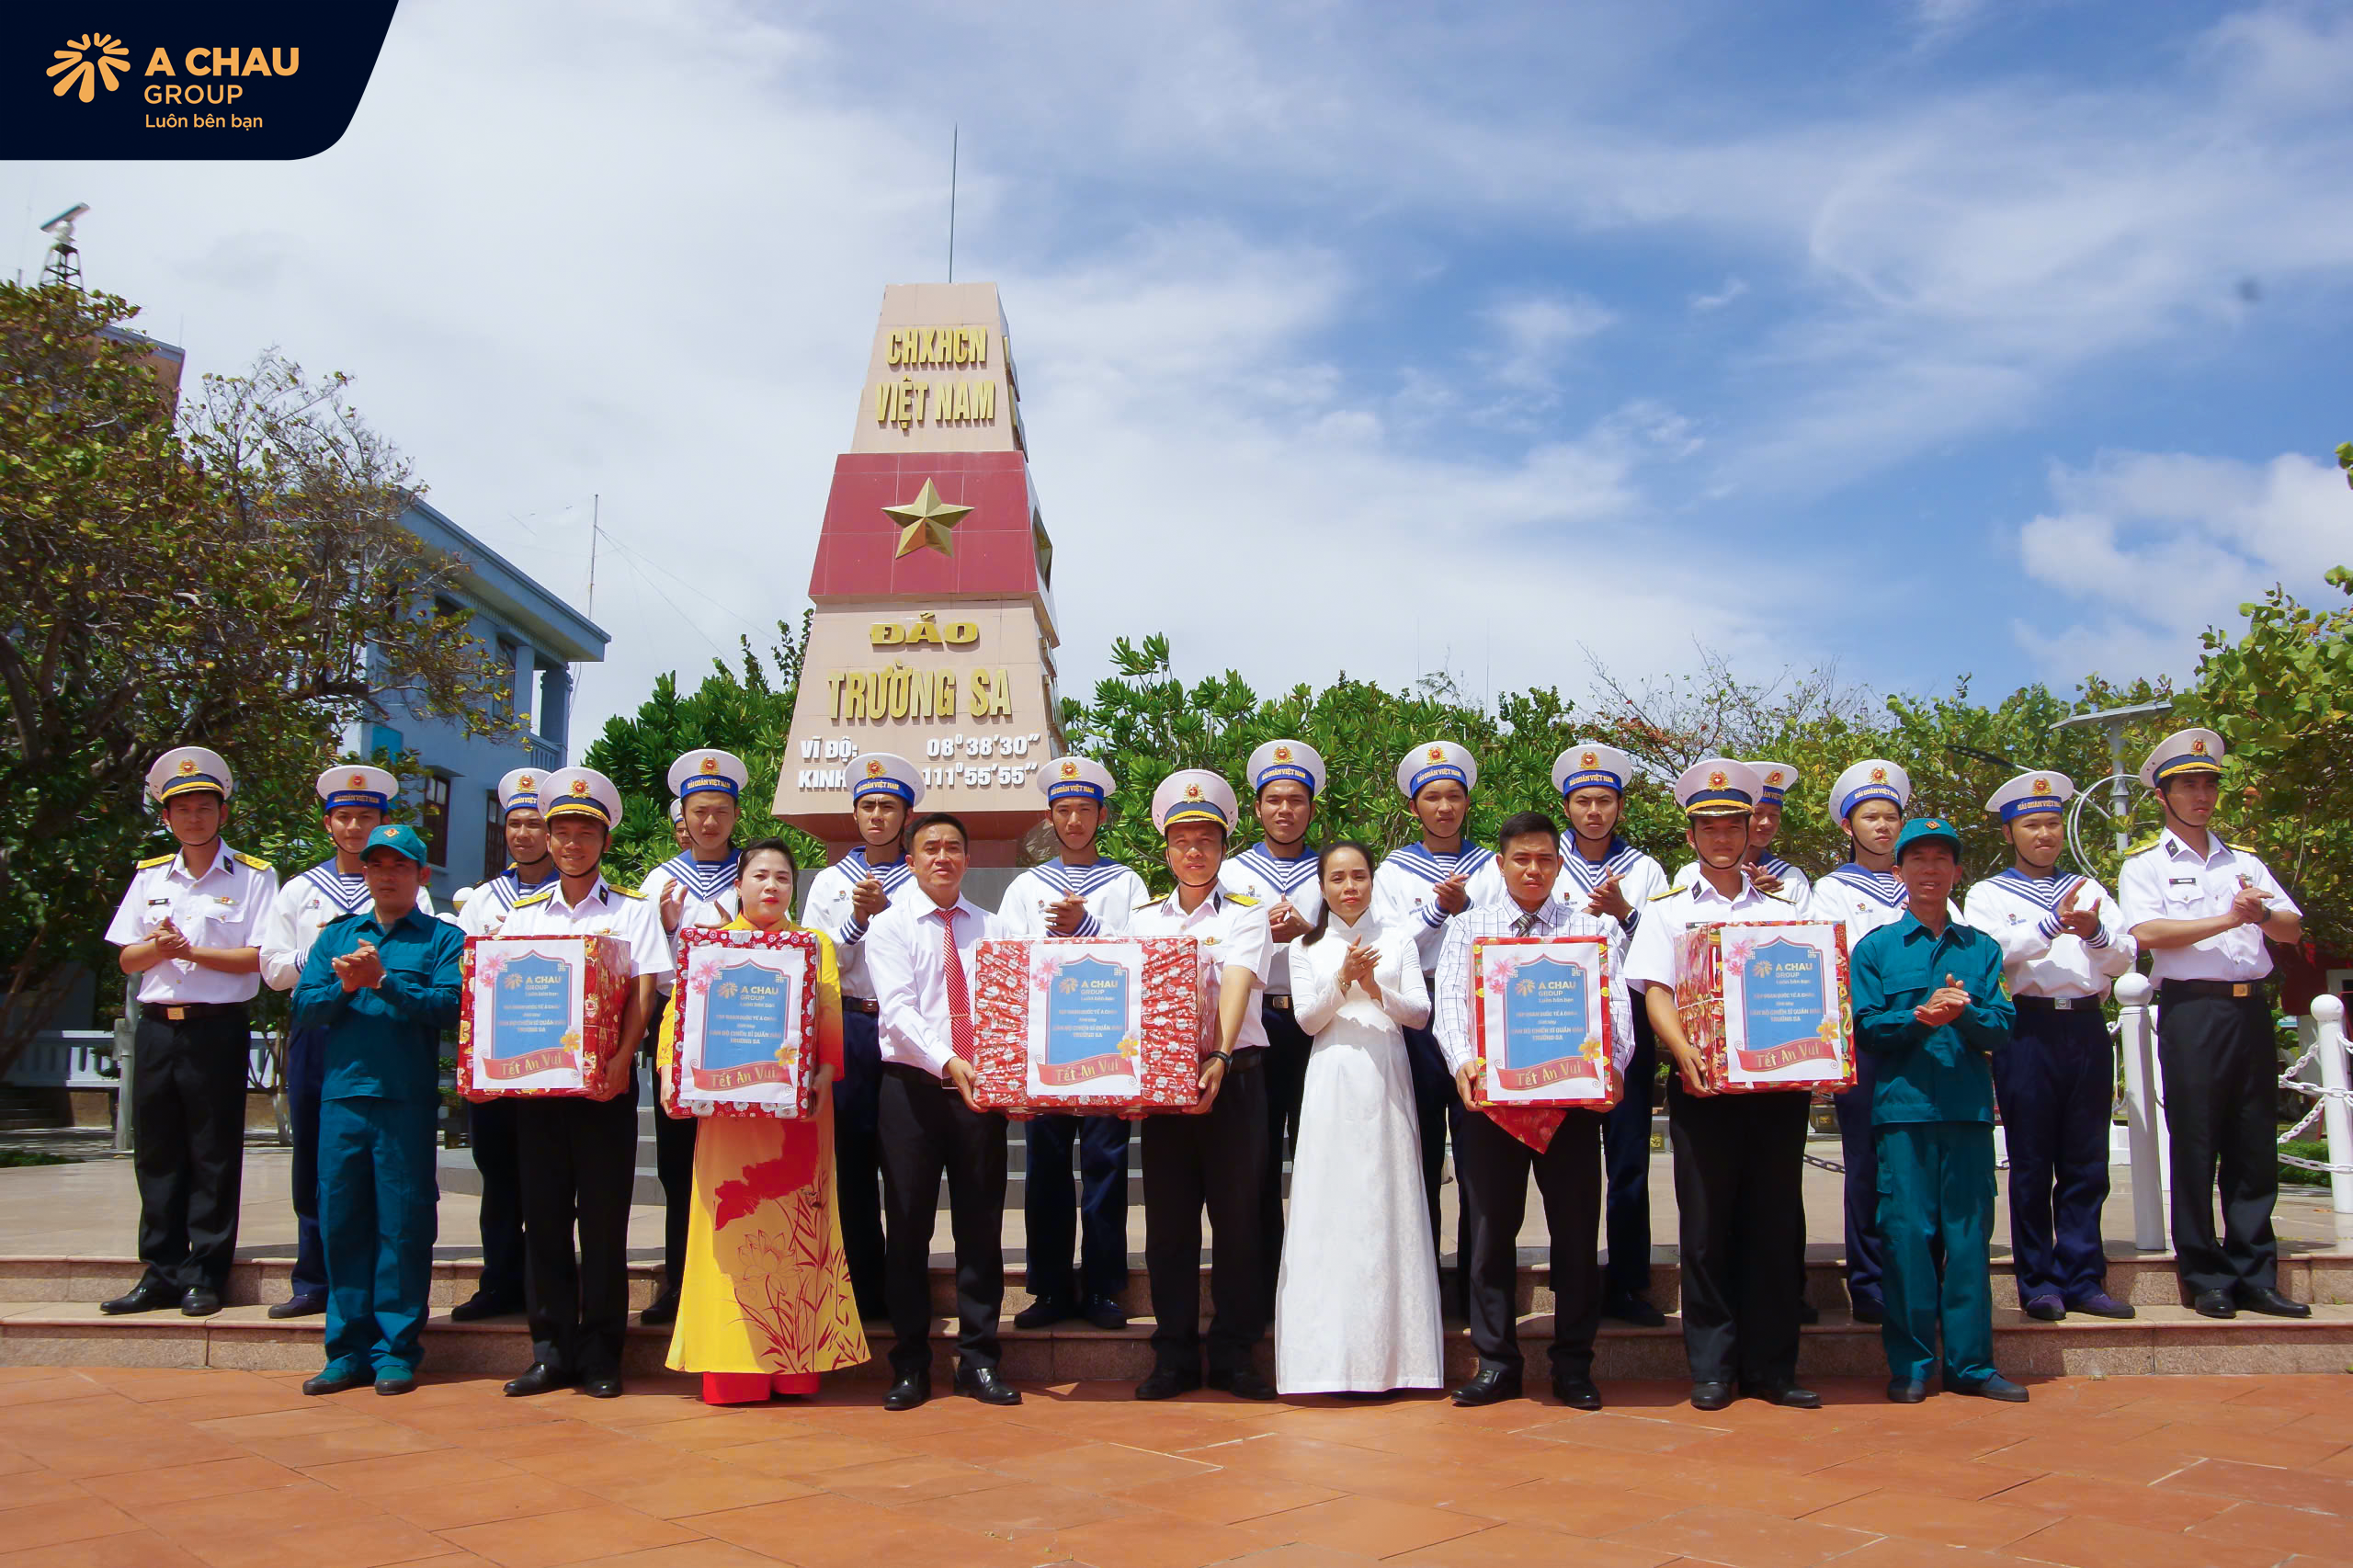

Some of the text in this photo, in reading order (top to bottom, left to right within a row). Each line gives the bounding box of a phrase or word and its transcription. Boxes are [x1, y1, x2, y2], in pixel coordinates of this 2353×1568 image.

[887, 326, 986, 365] CHXHCN
[876, 375, 995, 429] VIỆT NAM
[870, 612, 979, 643] ĐẢO
[828, 661, 1011, 719] TRƯỜNG SA
[801, 736, 823, 758] VĨ
[798, 769, 847, 788] KINH
[1785, 963, 1813, 971] CHAU
[535, 976, 562, 984] CHAU
[740, 985, 779, 994] A CHAU
[1090, 980, 1119, 988] CHAU
[1548, 981, 1576, 990] CHAU
[500, 1052, 563, 1075] Tết An Vui
[1756, 1043, 1819, 1067] Tết An Vui
[711, 1066, 776, 1086] Tết An Vui
[1056, 1058, 1119, 1081] Tết An Vui
[1517, 1062, 1581, 1085] Tết An Vui
